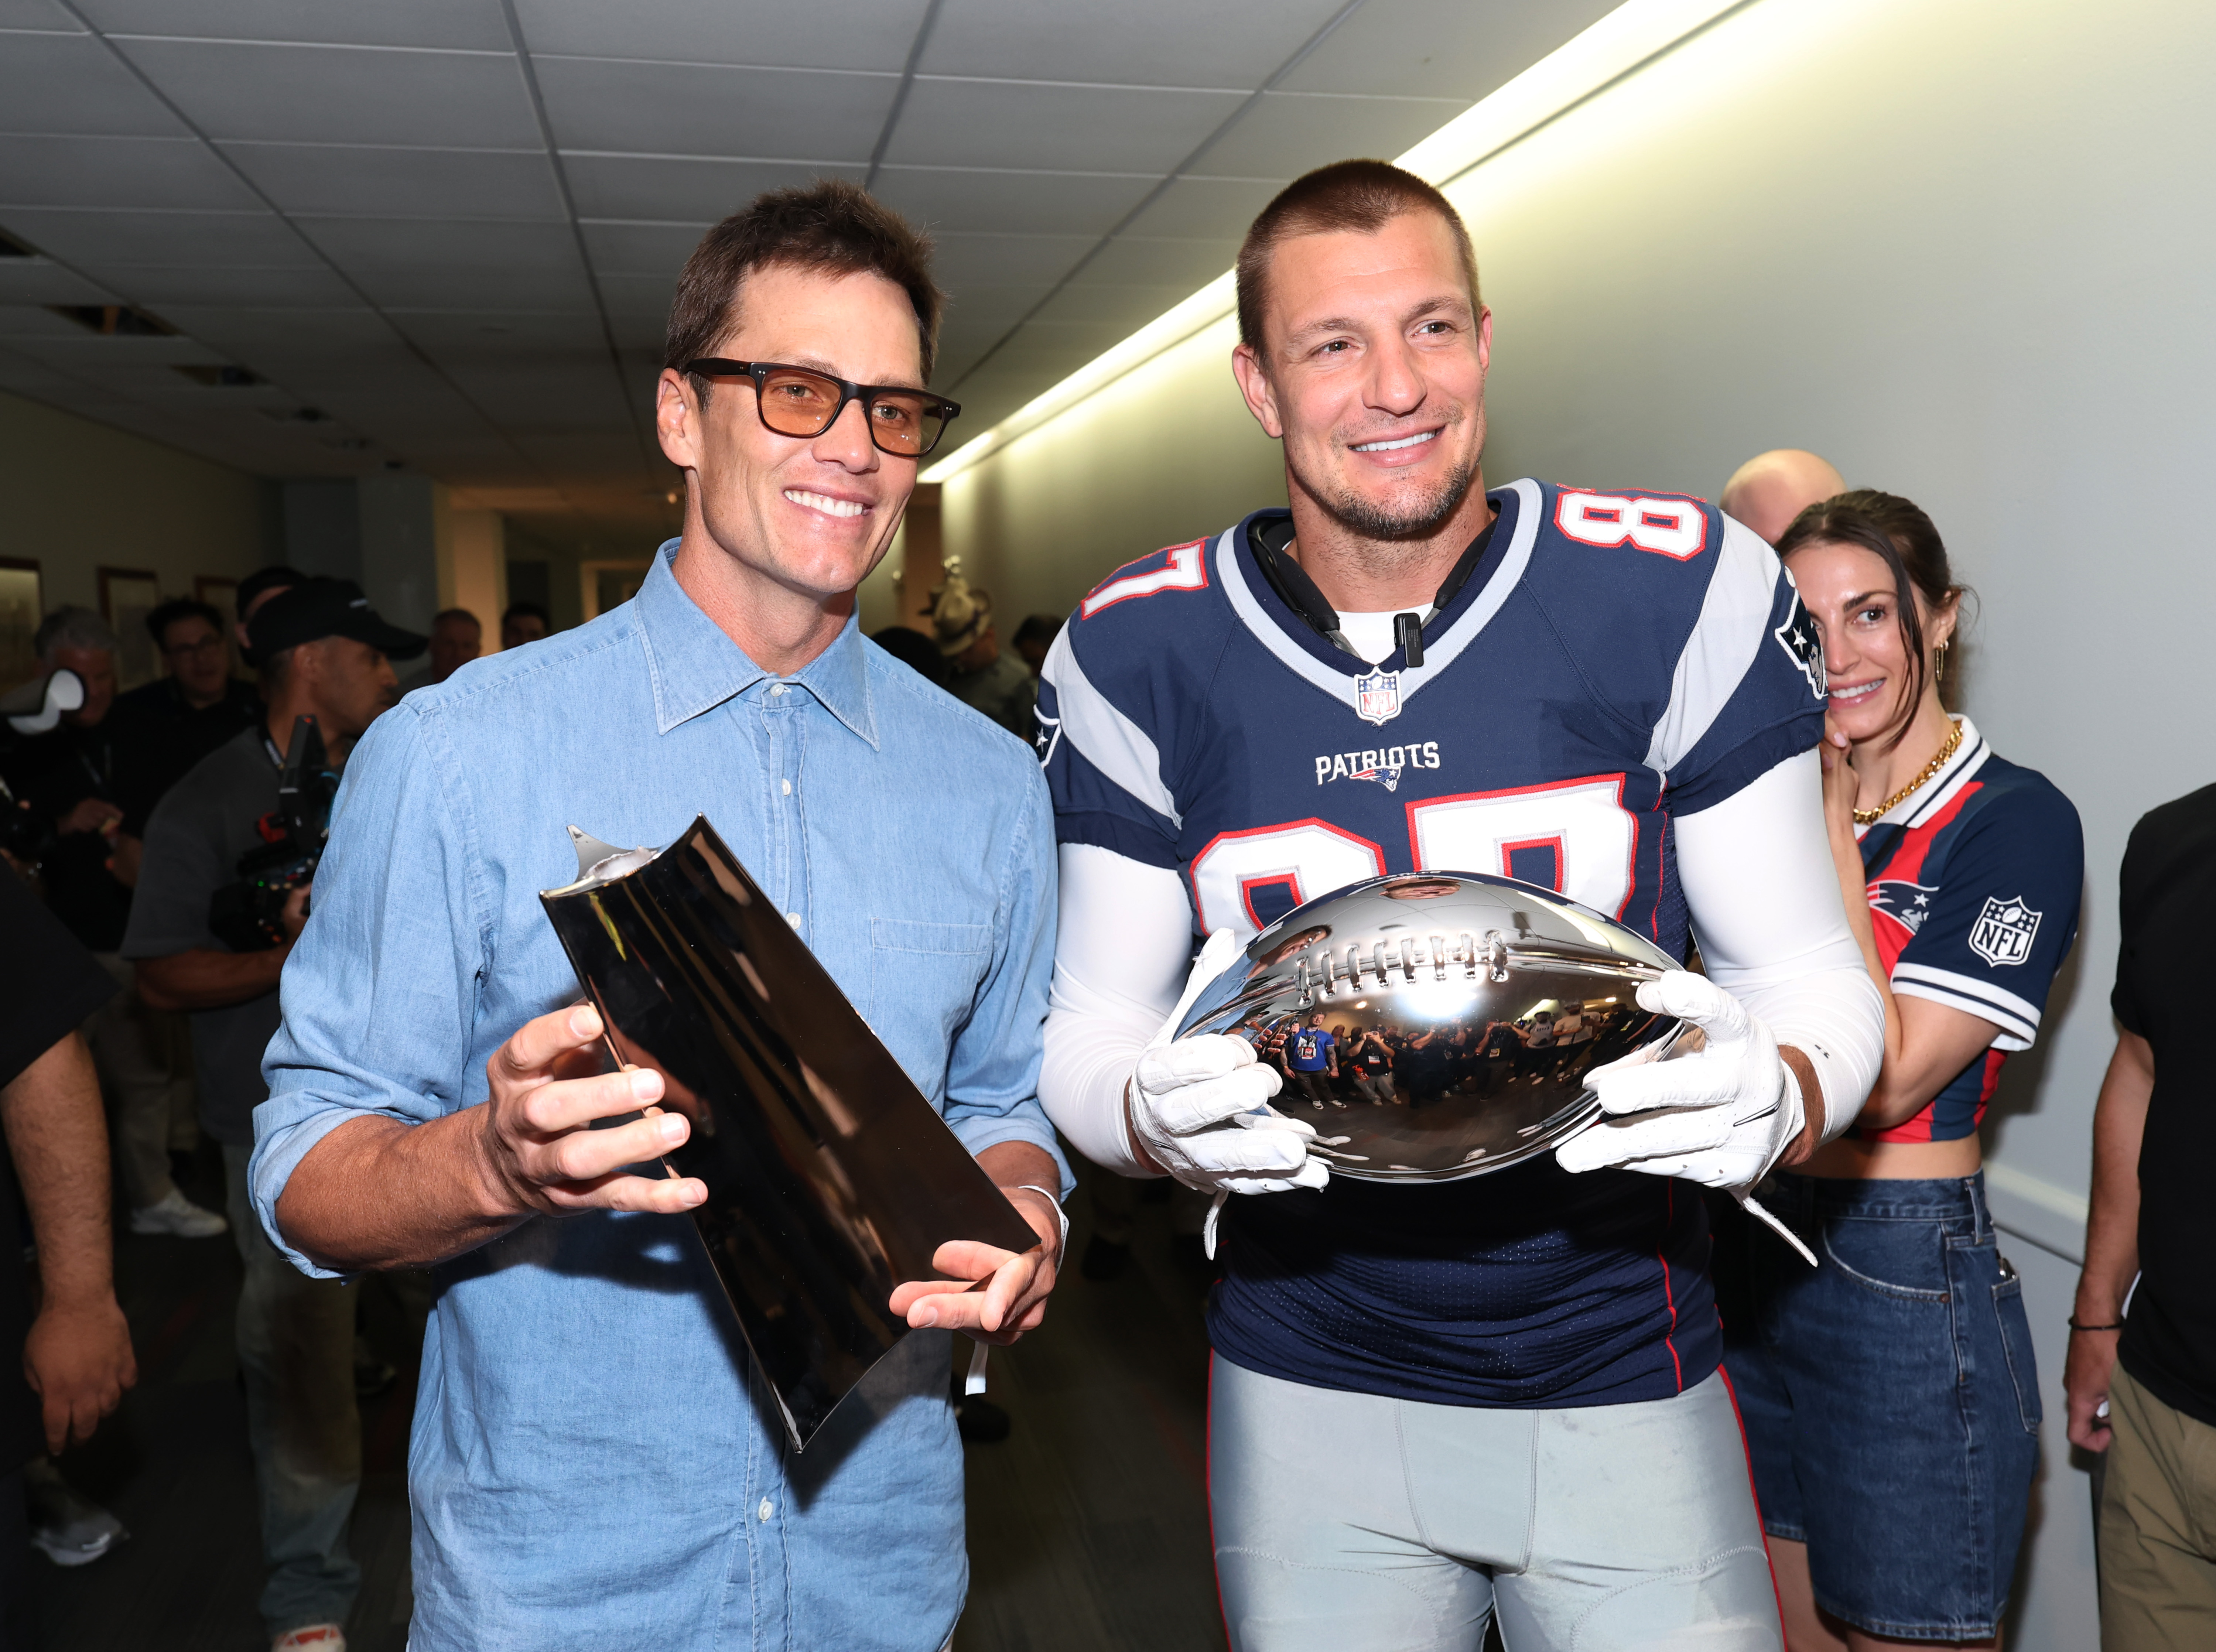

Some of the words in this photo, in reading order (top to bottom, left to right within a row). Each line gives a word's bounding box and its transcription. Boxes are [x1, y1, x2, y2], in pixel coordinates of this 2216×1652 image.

[1554, 483, 1708, 562] 8
[1080, 536, 1210, 621] 7
[1362, 692, 1395, 715] NFL
[1315, 741, 1441, 786] PATRIOTS
[1977, 921, 2022, 957] NFL
